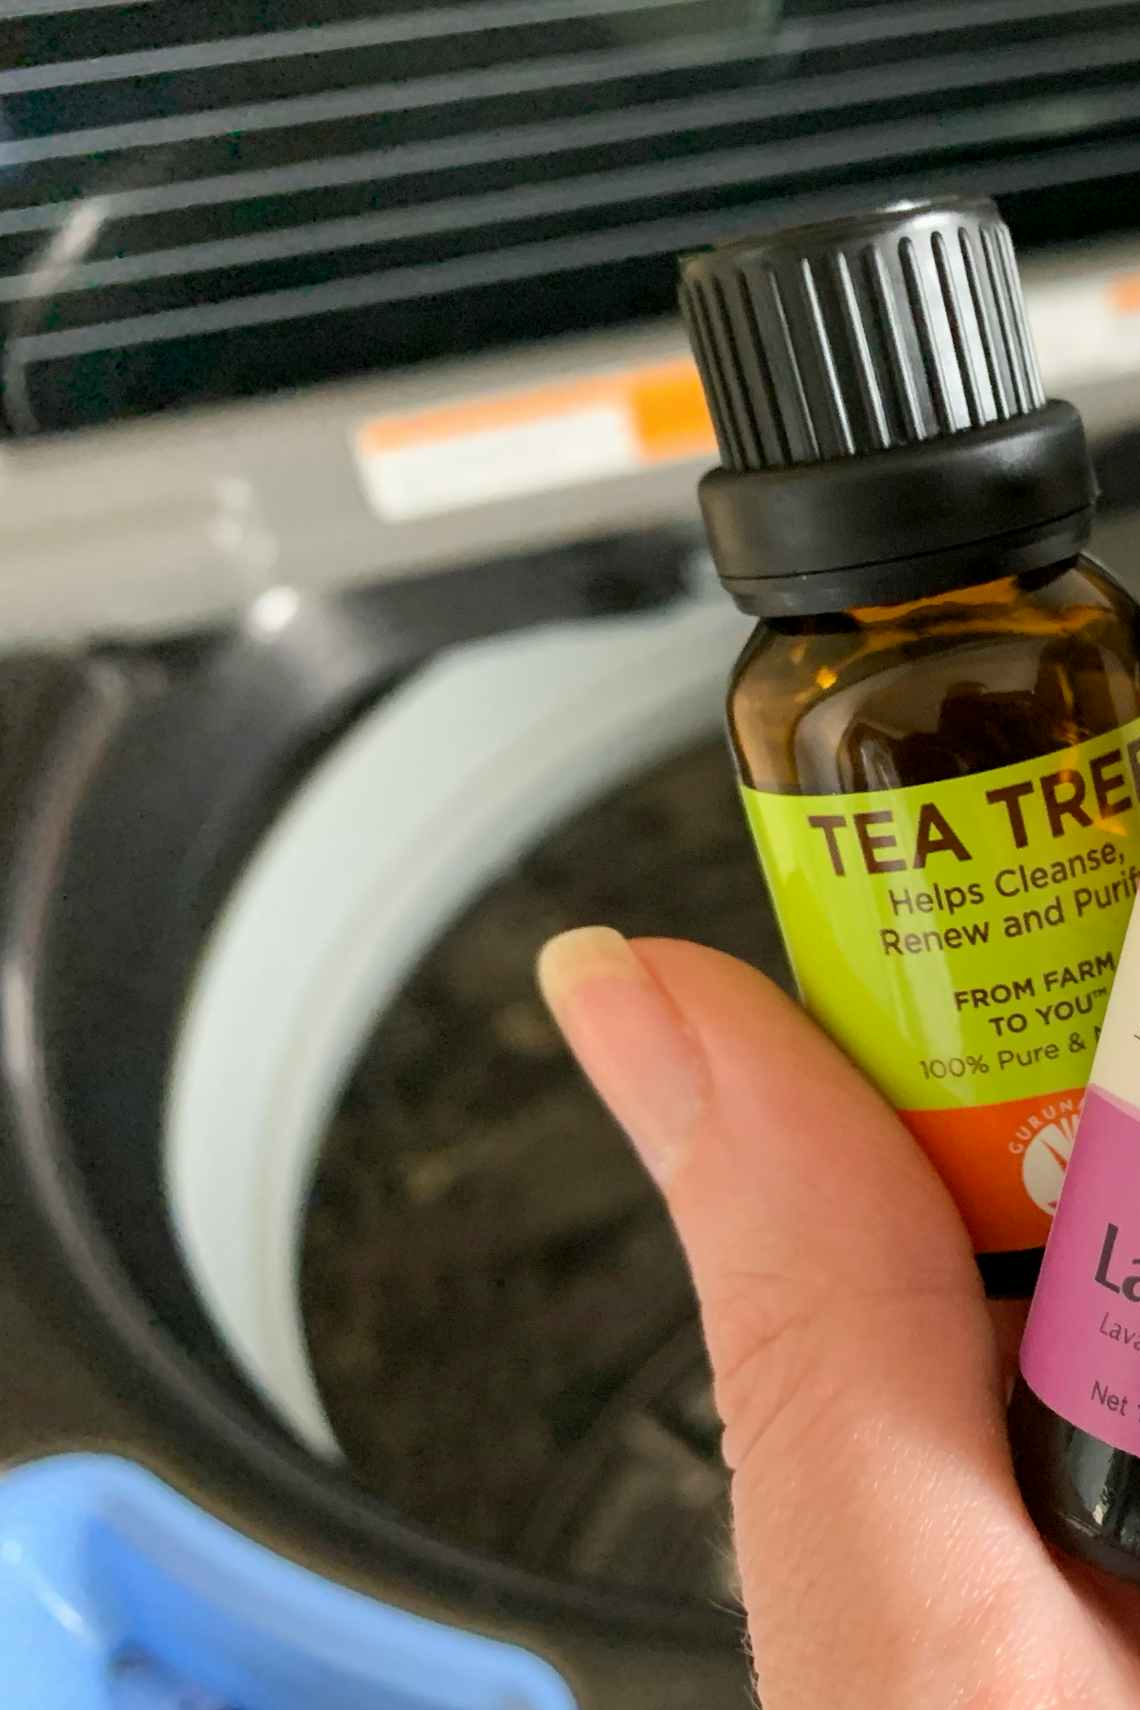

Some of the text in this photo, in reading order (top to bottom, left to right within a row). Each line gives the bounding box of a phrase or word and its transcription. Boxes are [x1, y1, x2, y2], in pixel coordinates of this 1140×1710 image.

[808, 803, 972, 876] TEA
[888, 842, 1125, 916] Helps Cleanse,
[881, 919, 990, 956] Renew
[1004, 899, 1064, 938] and
[954, 952, 1116, 1011] FROM FARM
[988, 1013, 1027, 1037] TO
[920, 1055, 990, 1080] 100%
[997, 1043, 1059, 1070] Pure
[1068, 1031, 1086, 1053] &
[1091, 1380, 1128, 1416] Net
